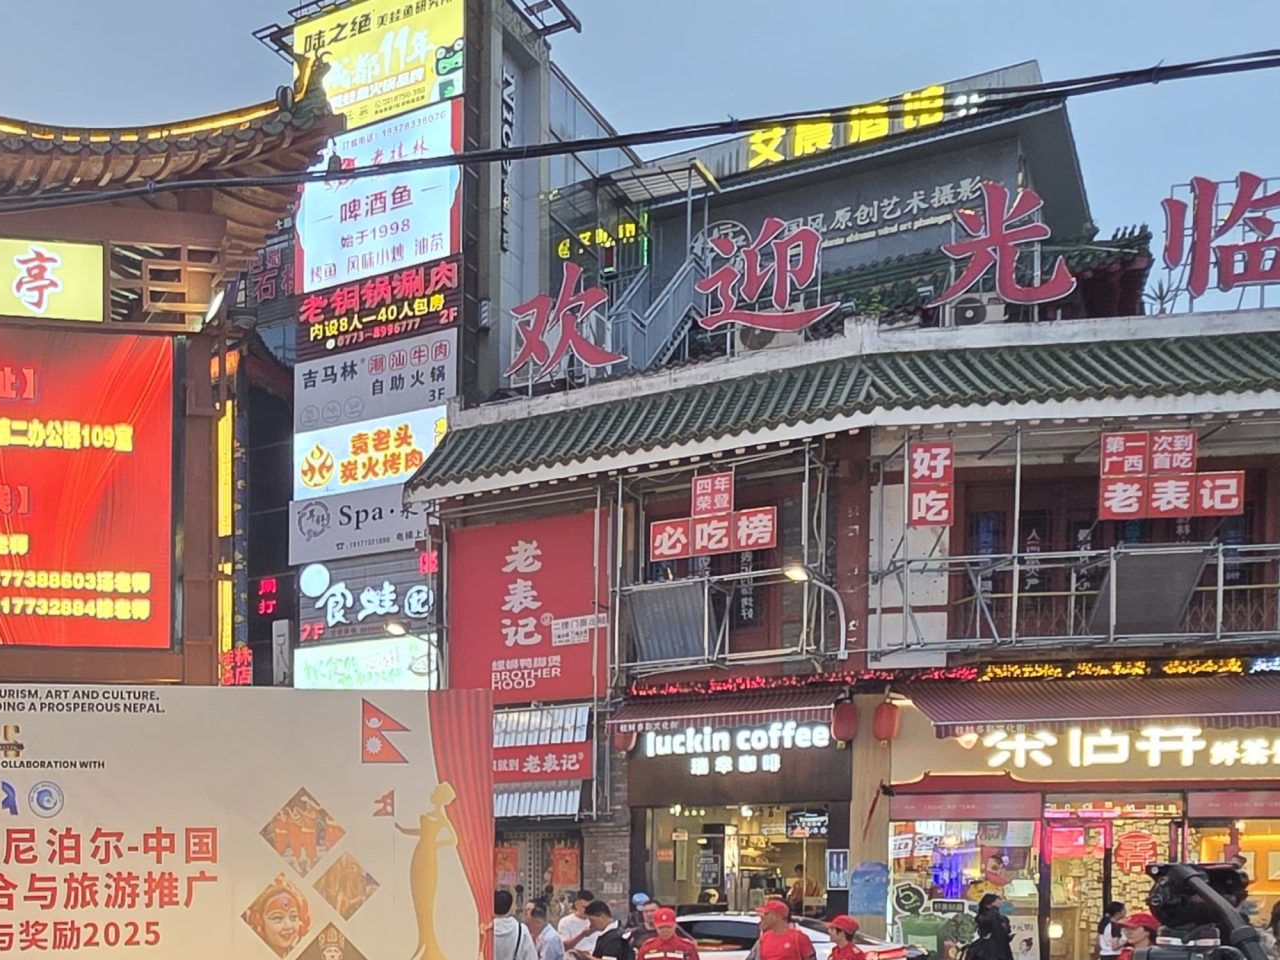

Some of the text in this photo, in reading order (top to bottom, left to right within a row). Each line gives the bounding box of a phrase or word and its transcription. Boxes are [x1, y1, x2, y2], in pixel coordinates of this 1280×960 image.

[339, 185, 414, 224] 啤酒鱼
[341, 219, 411, 249] 始于1998
[299, 261, 460, 324] 老铜锅涮肉
[439, 308, 458, 326] 2F
[368, 339, 451, 375] 潮汕牛肉
[302, 359, 358, 390] 吉马林
[371, 367, 446, 396] 自助火锅
[429, 388, 446, 402] 3F
[340, 450, 425, 485] 炭火烤肉
[696, 473, 731, 494] 四年
[1104, 479, 1240, 512] 老表记
[696, 492, 731, 512] 荣登
[339, 504, 384, 531] Spa
[654, 513, 775, 558] 必吃榜
[501, 539, 543, 648] 老表记
[491, 667, 562, 682] BROTHER
[491, 678, 537, 691] HOOD
[28, 702, 37, 712] A
[39, 702, 122, 713] PROSPEROUS
[123, 703, 166, 714] NEPAL.
[45, 690, 70, 701] ART
[72, 690, 100, 701] AND
[102, 690, 160, 702] CULTURE.
[645, 720, 830, 758] luckin coffee
[79, 760, 105, 770] WITH
[690, 753, 782, 777] 瑞幸咖啡
[3, 826, 219, 865] 尼泊尔-中国
